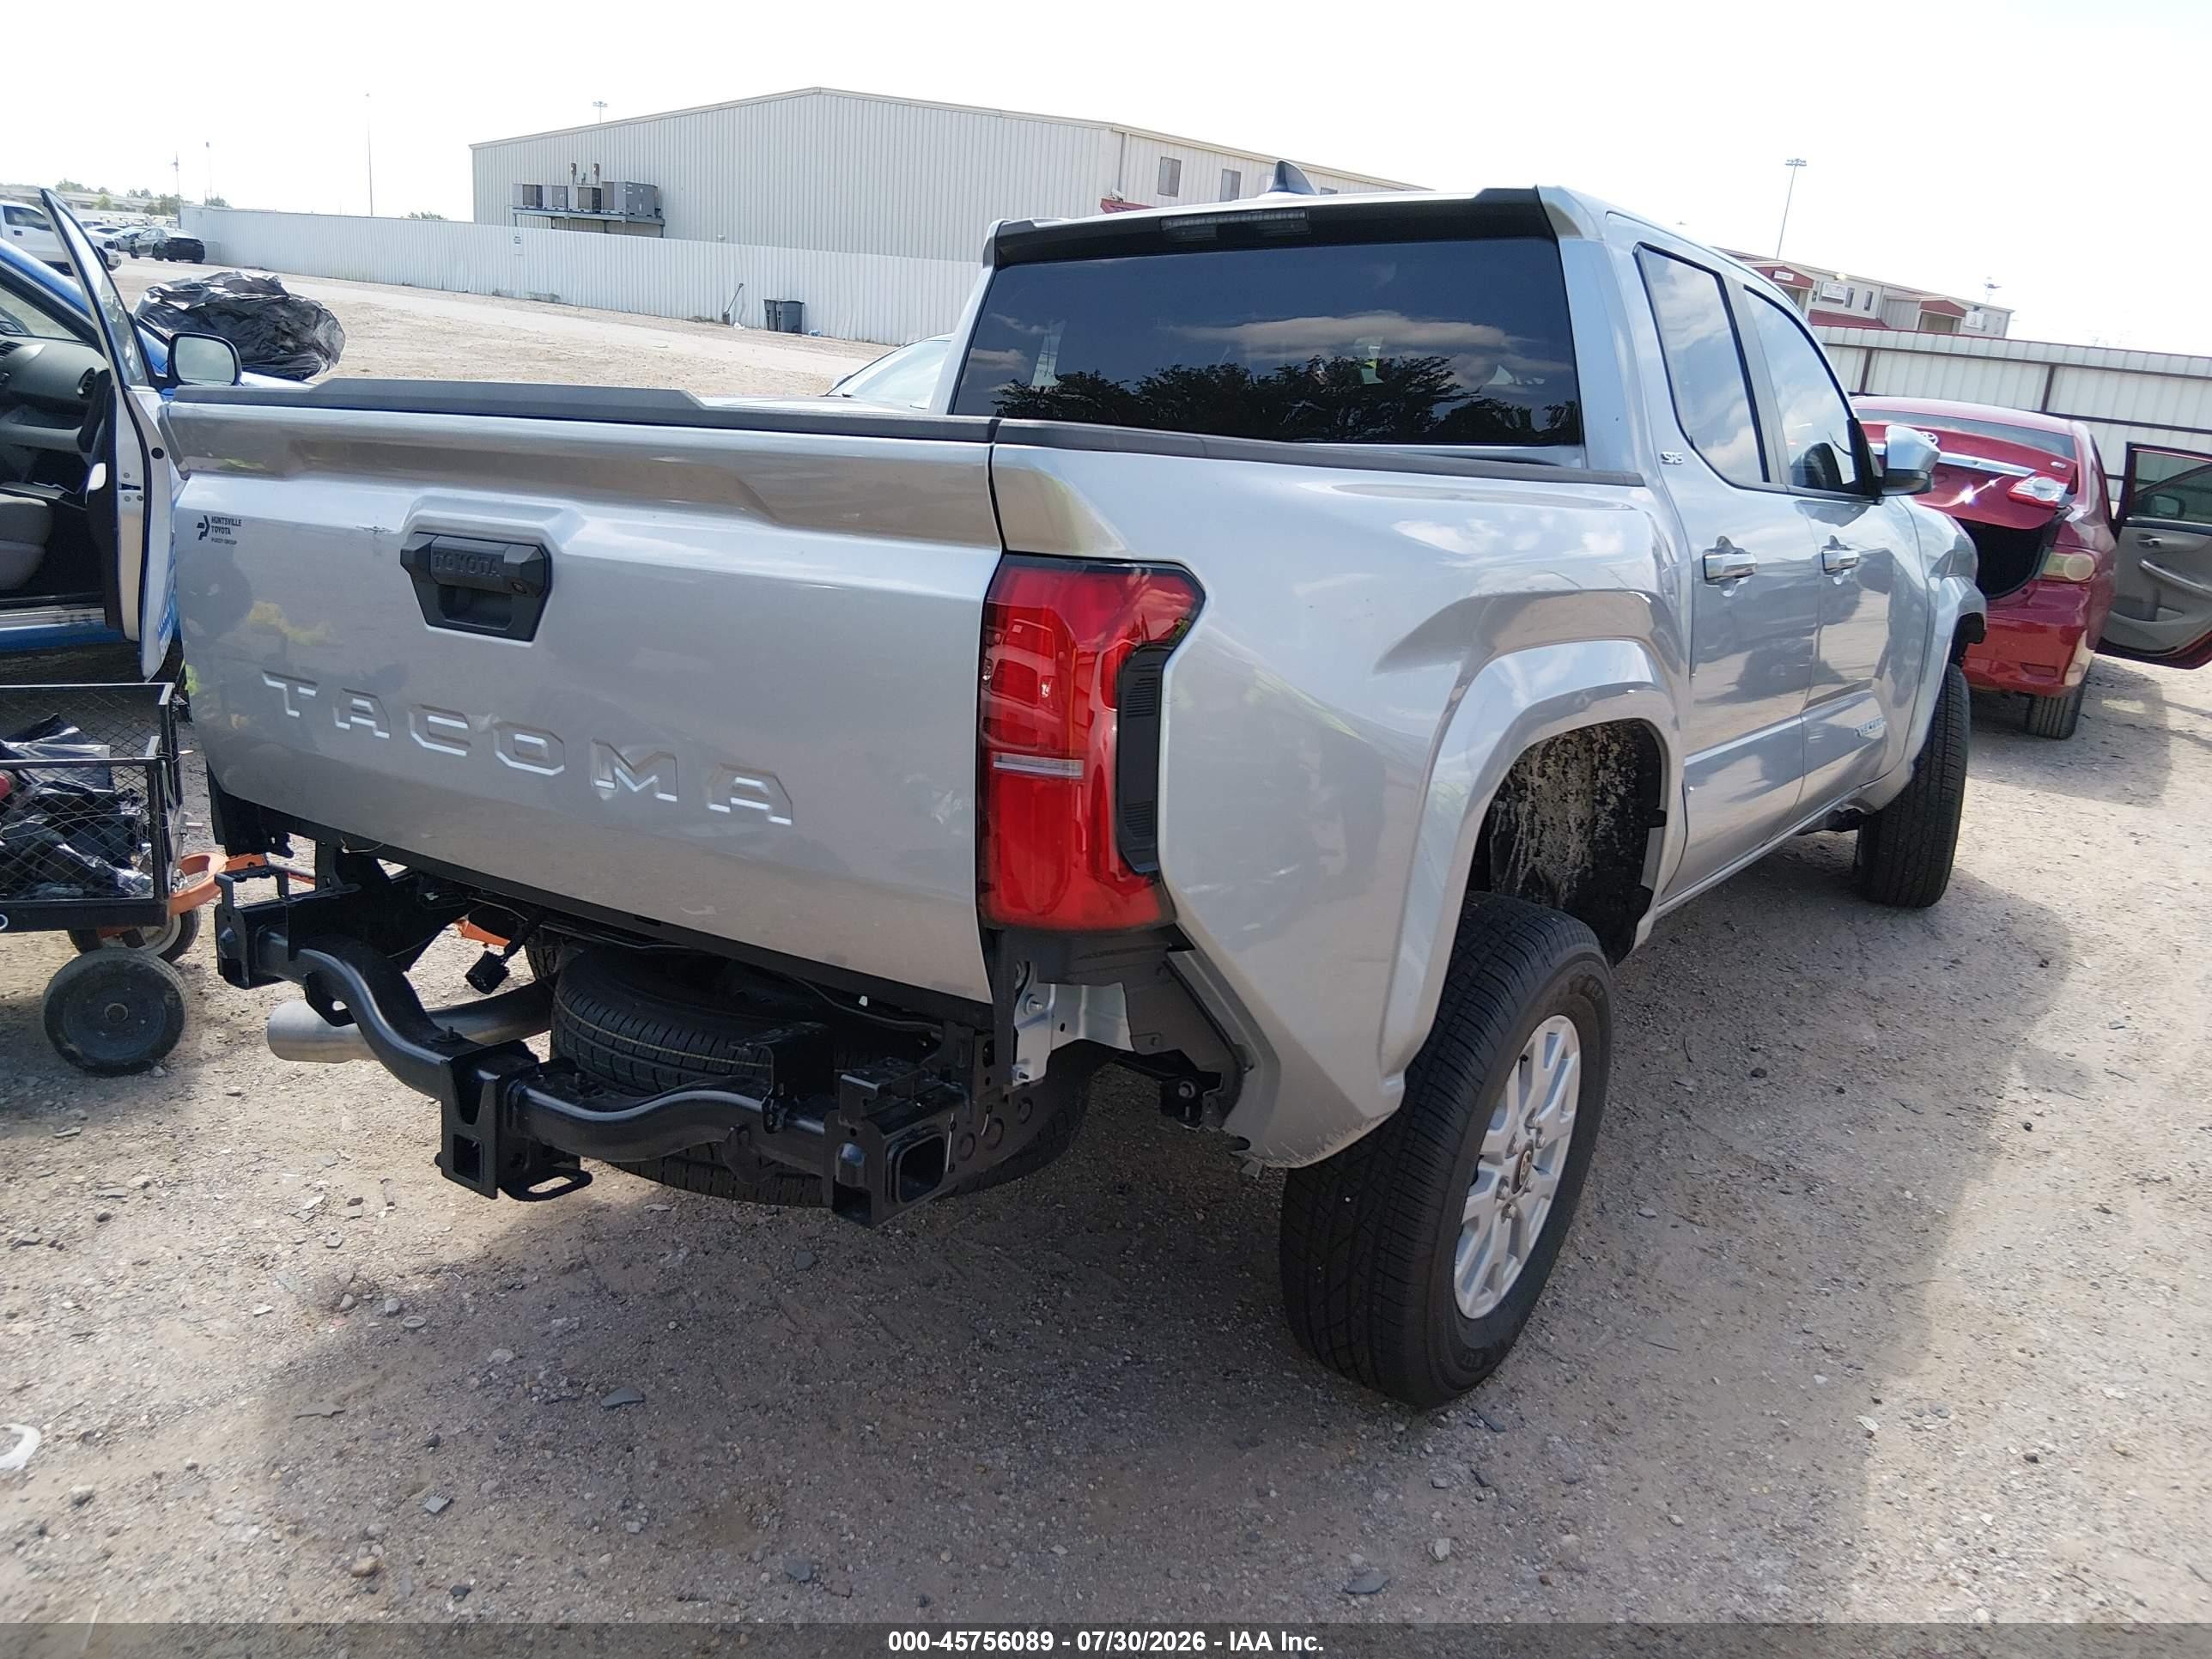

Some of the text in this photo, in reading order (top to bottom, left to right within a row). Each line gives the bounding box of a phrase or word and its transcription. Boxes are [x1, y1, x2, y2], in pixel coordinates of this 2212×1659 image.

[1661, 451, 1684, 465] SR5
[211, 515, 242, 527] HUNTSVILLE
[211, 525, 232, 535] TOYOTA
[433, 550, 501, 578] TOYOTA
[262, 669, 793, 825] TACOMA
